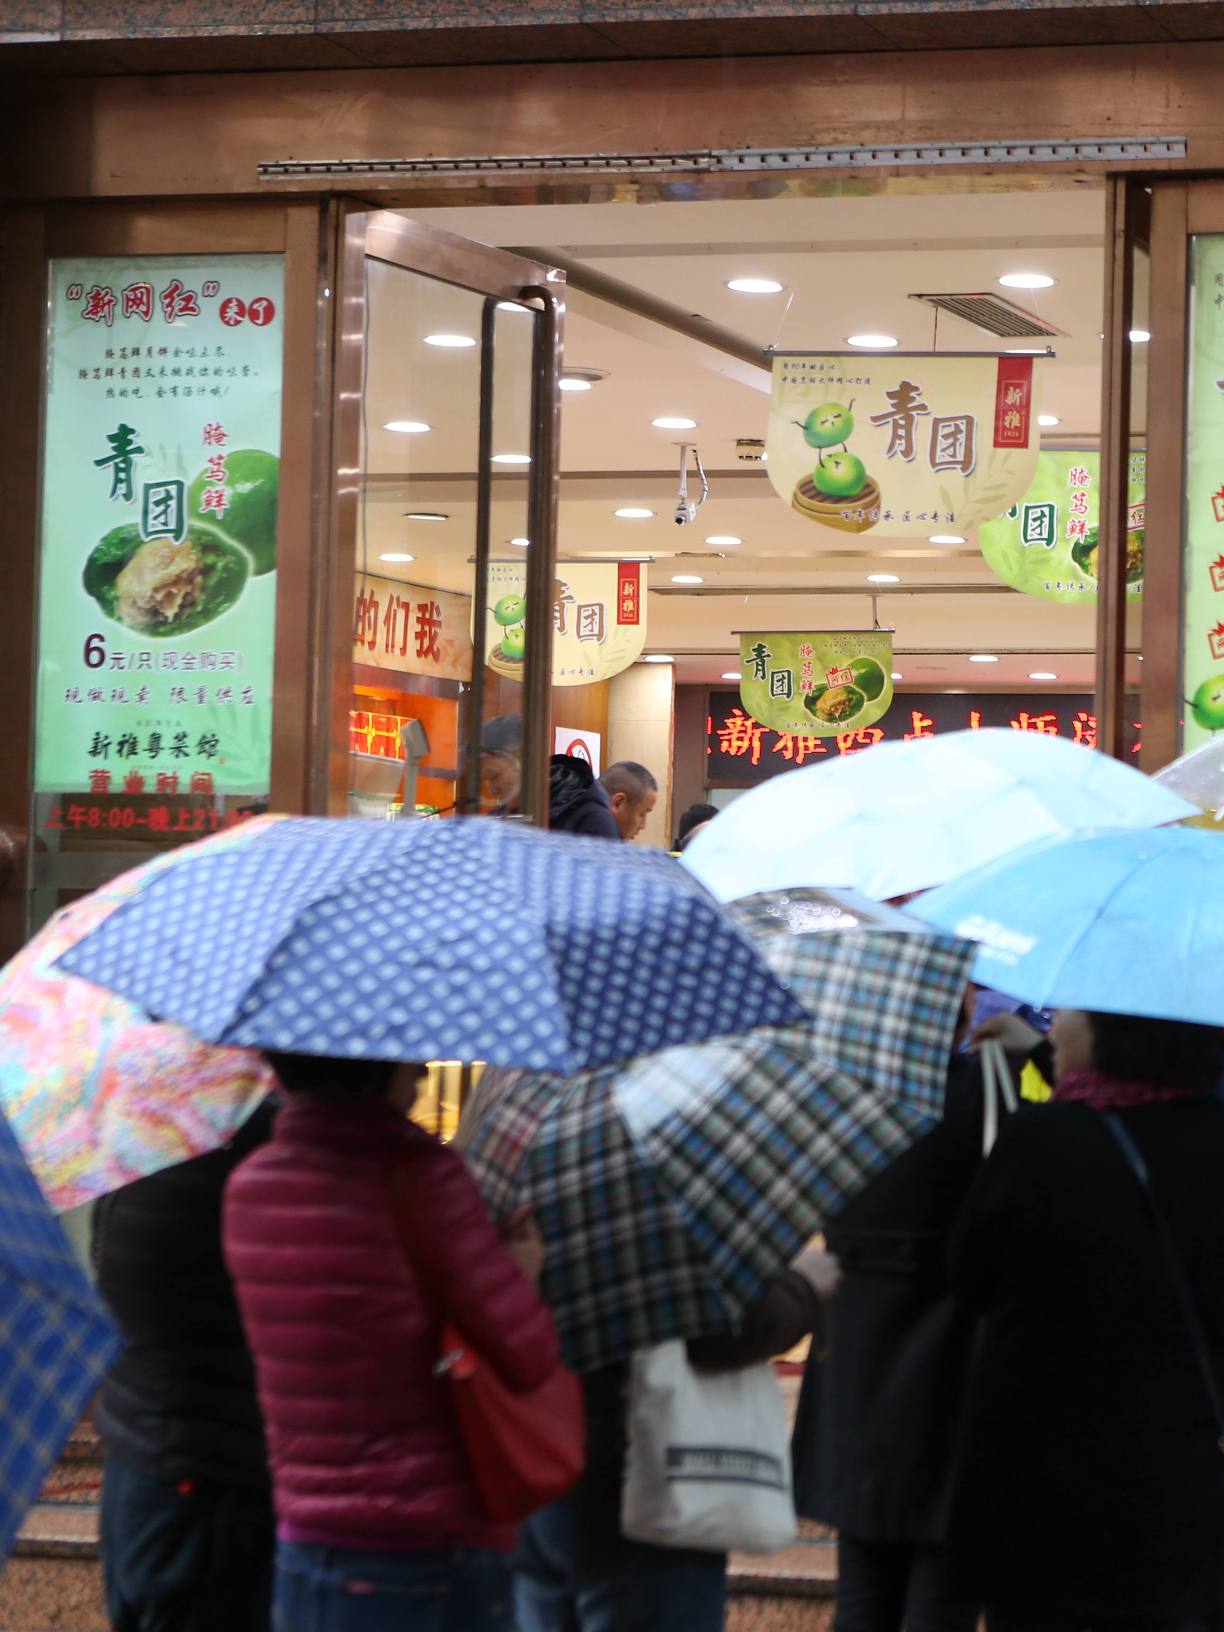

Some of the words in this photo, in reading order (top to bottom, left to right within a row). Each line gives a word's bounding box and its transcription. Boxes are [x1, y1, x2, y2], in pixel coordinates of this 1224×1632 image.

[869, 380, 977, 475] 青团
[1004, 386, 1022, 430] 新雅
[92, 422, 186, 543] 青团
[202, 421, 230, 519] 腌笃鲜
[1067, 467, 1091, 542] 腌笃鲜
[64, 686, 151, 704] 现做现卖
[745, 643, 793, 699] 青团
[799, 644, 815, 695] 腌笃鲜
[87, 731, 221, 761] 新雅粤菜馆
[88, 768, 214, 796] 营业时间
